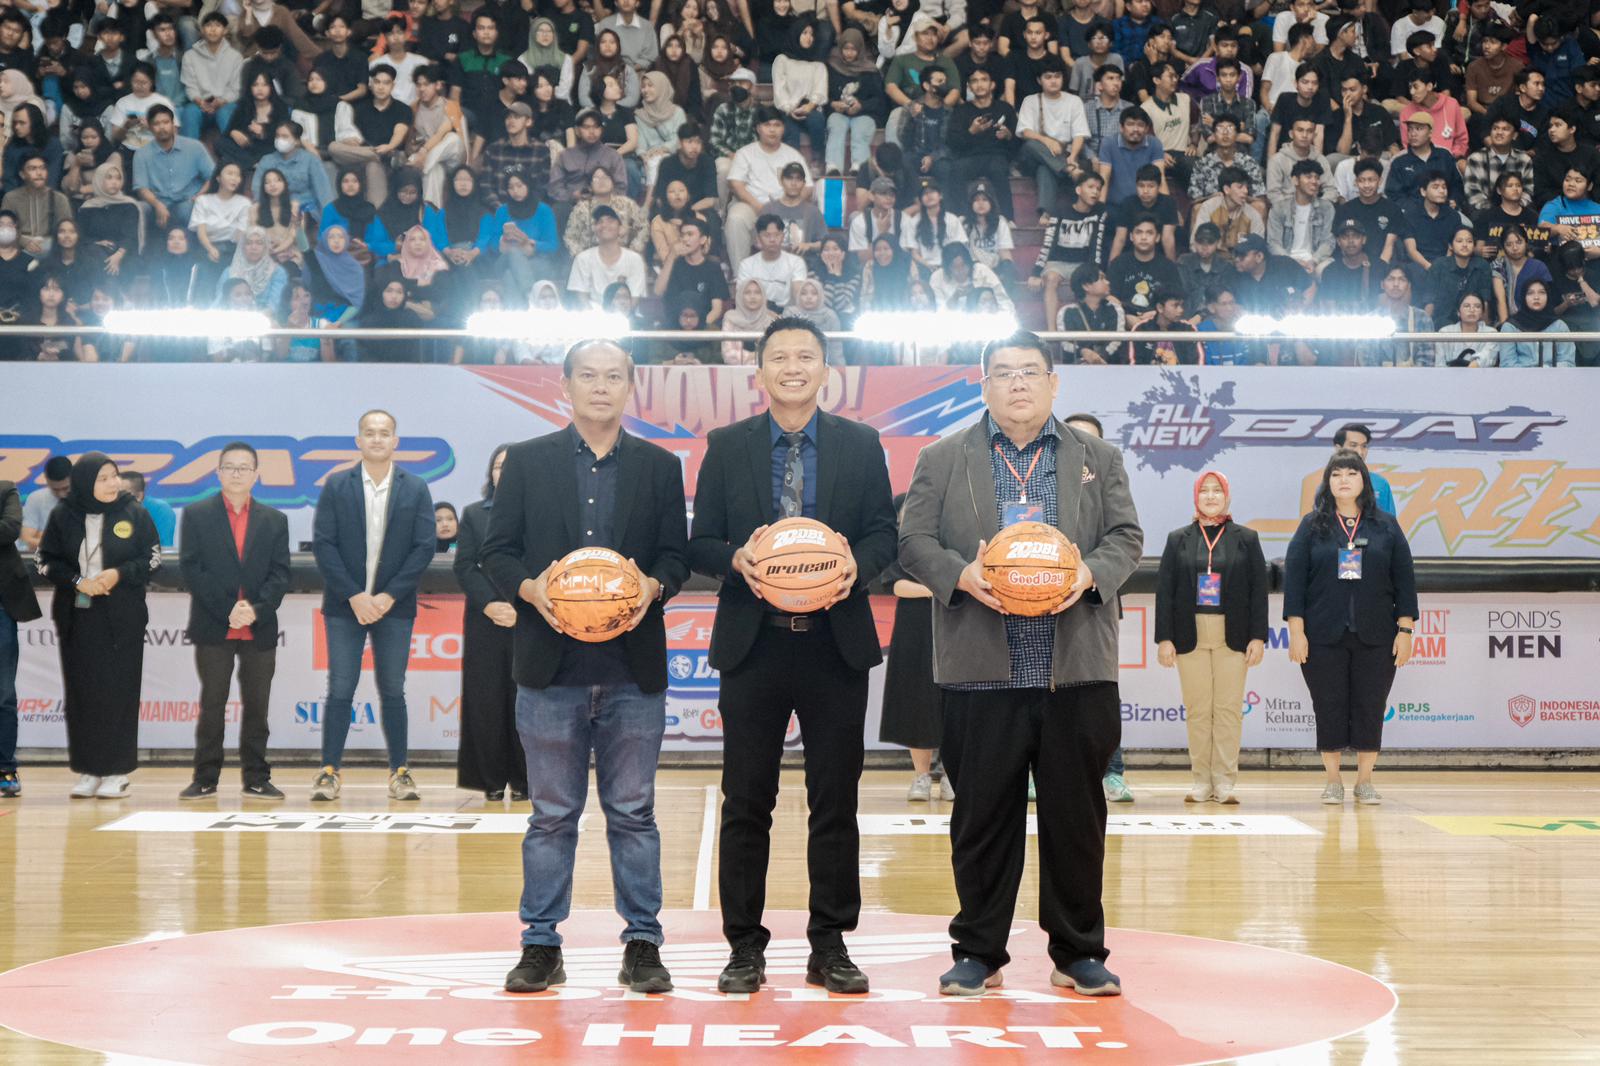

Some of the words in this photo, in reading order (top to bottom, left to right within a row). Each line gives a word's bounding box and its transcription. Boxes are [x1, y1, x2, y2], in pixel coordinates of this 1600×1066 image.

[1559, 216, 1580, 225] HAVE
[1149, 403, 1210, 425] ALL
[1129, 425, 1209, 447] NEW
[766, 559, 837, 576] proteam
[1009, 570, 1041, 585] Good
[1042, 571, 1064, 587] Day
[1488, 610, 1561, 629] POND'S
[1489, 636, 1561, 658] MEN
[1120, 703, 1187, 722] Biznet
[1265, 698, 1301, 710] Mitra
[1399, 703, 1430, 713] BPJS
[1540, 701, 1600, 711] INDONESIA
[1265, 711, 1316, 727] Keluarg
[1399, 713, 1475, 724] Ketenagakerjaan
[206, 821, 479, 831] MEN
[228, 1021, 543, 1047] One
[581, 1022, 1129, 1049] HEART.
